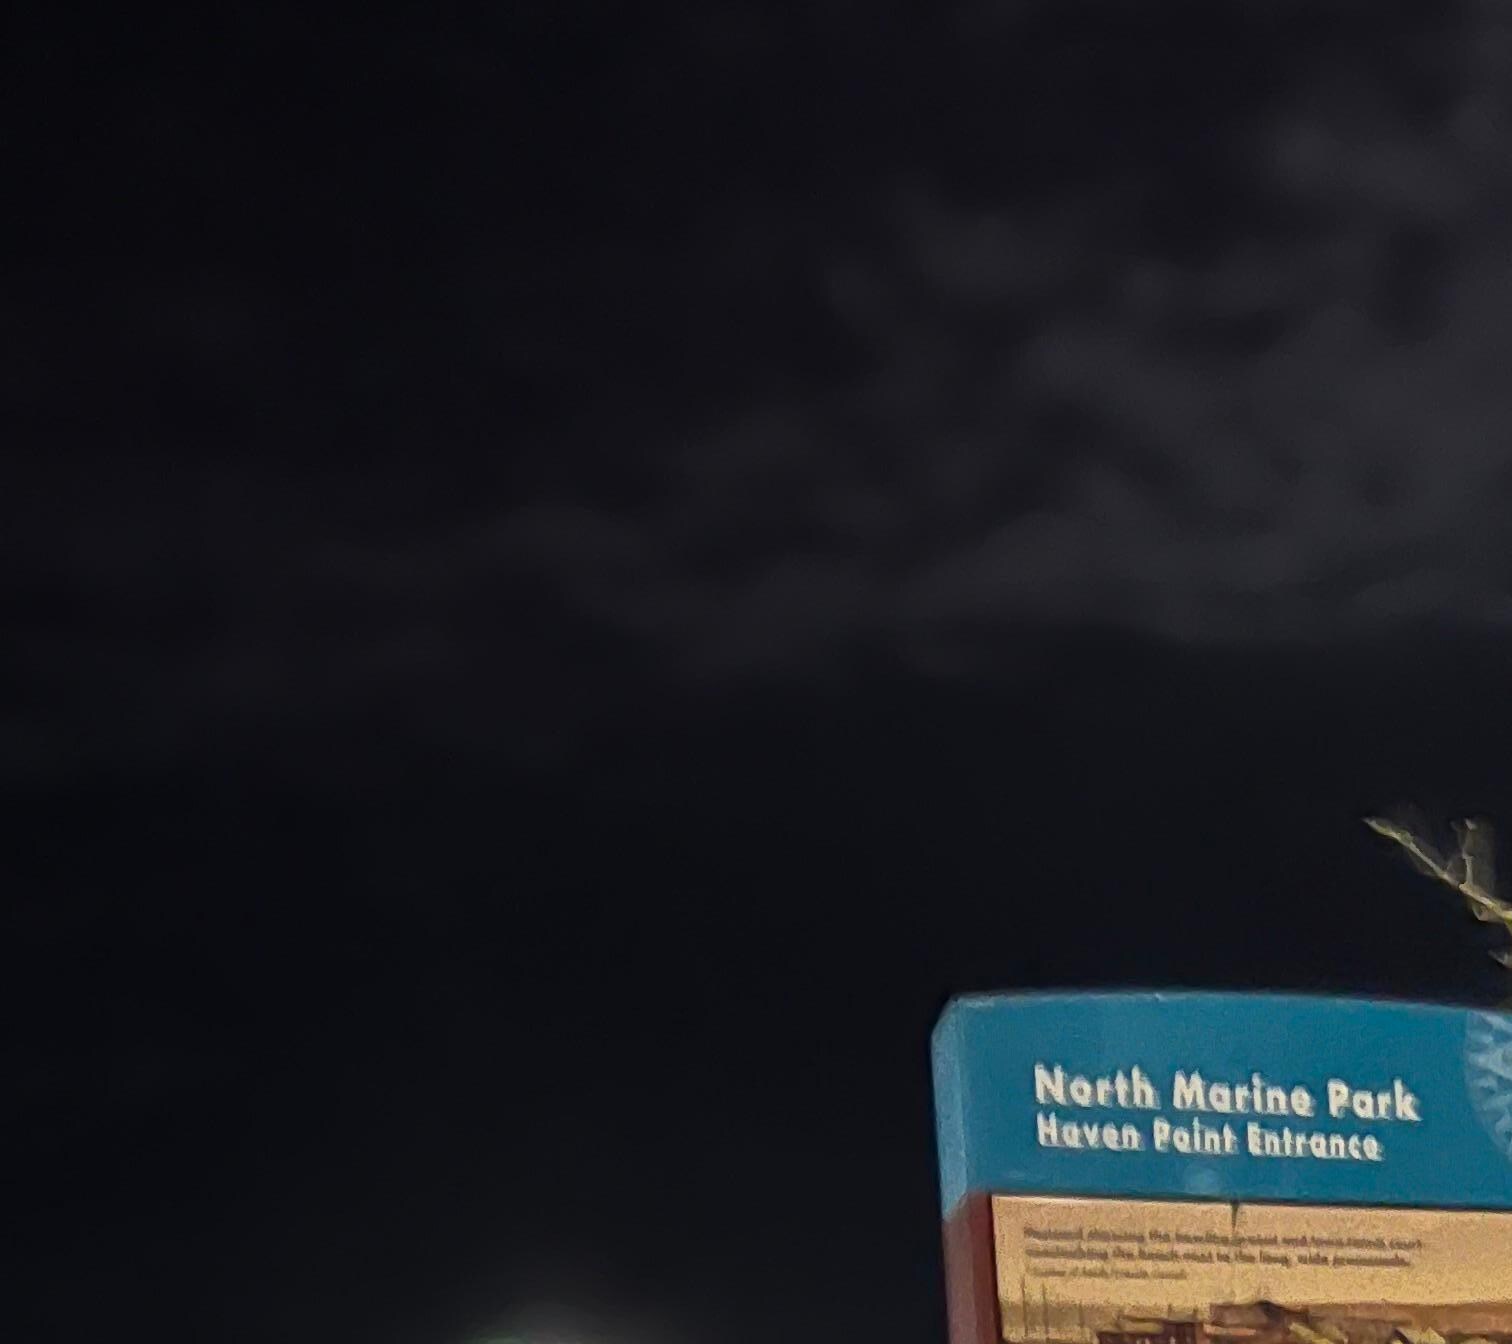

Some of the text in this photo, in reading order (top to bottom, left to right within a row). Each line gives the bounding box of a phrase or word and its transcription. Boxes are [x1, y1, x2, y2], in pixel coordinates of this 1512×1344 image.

[1034, 1061, 1423, 1121] North Marine Park
[1036, 1110, 1385, 1162] Haven Point Entrance
